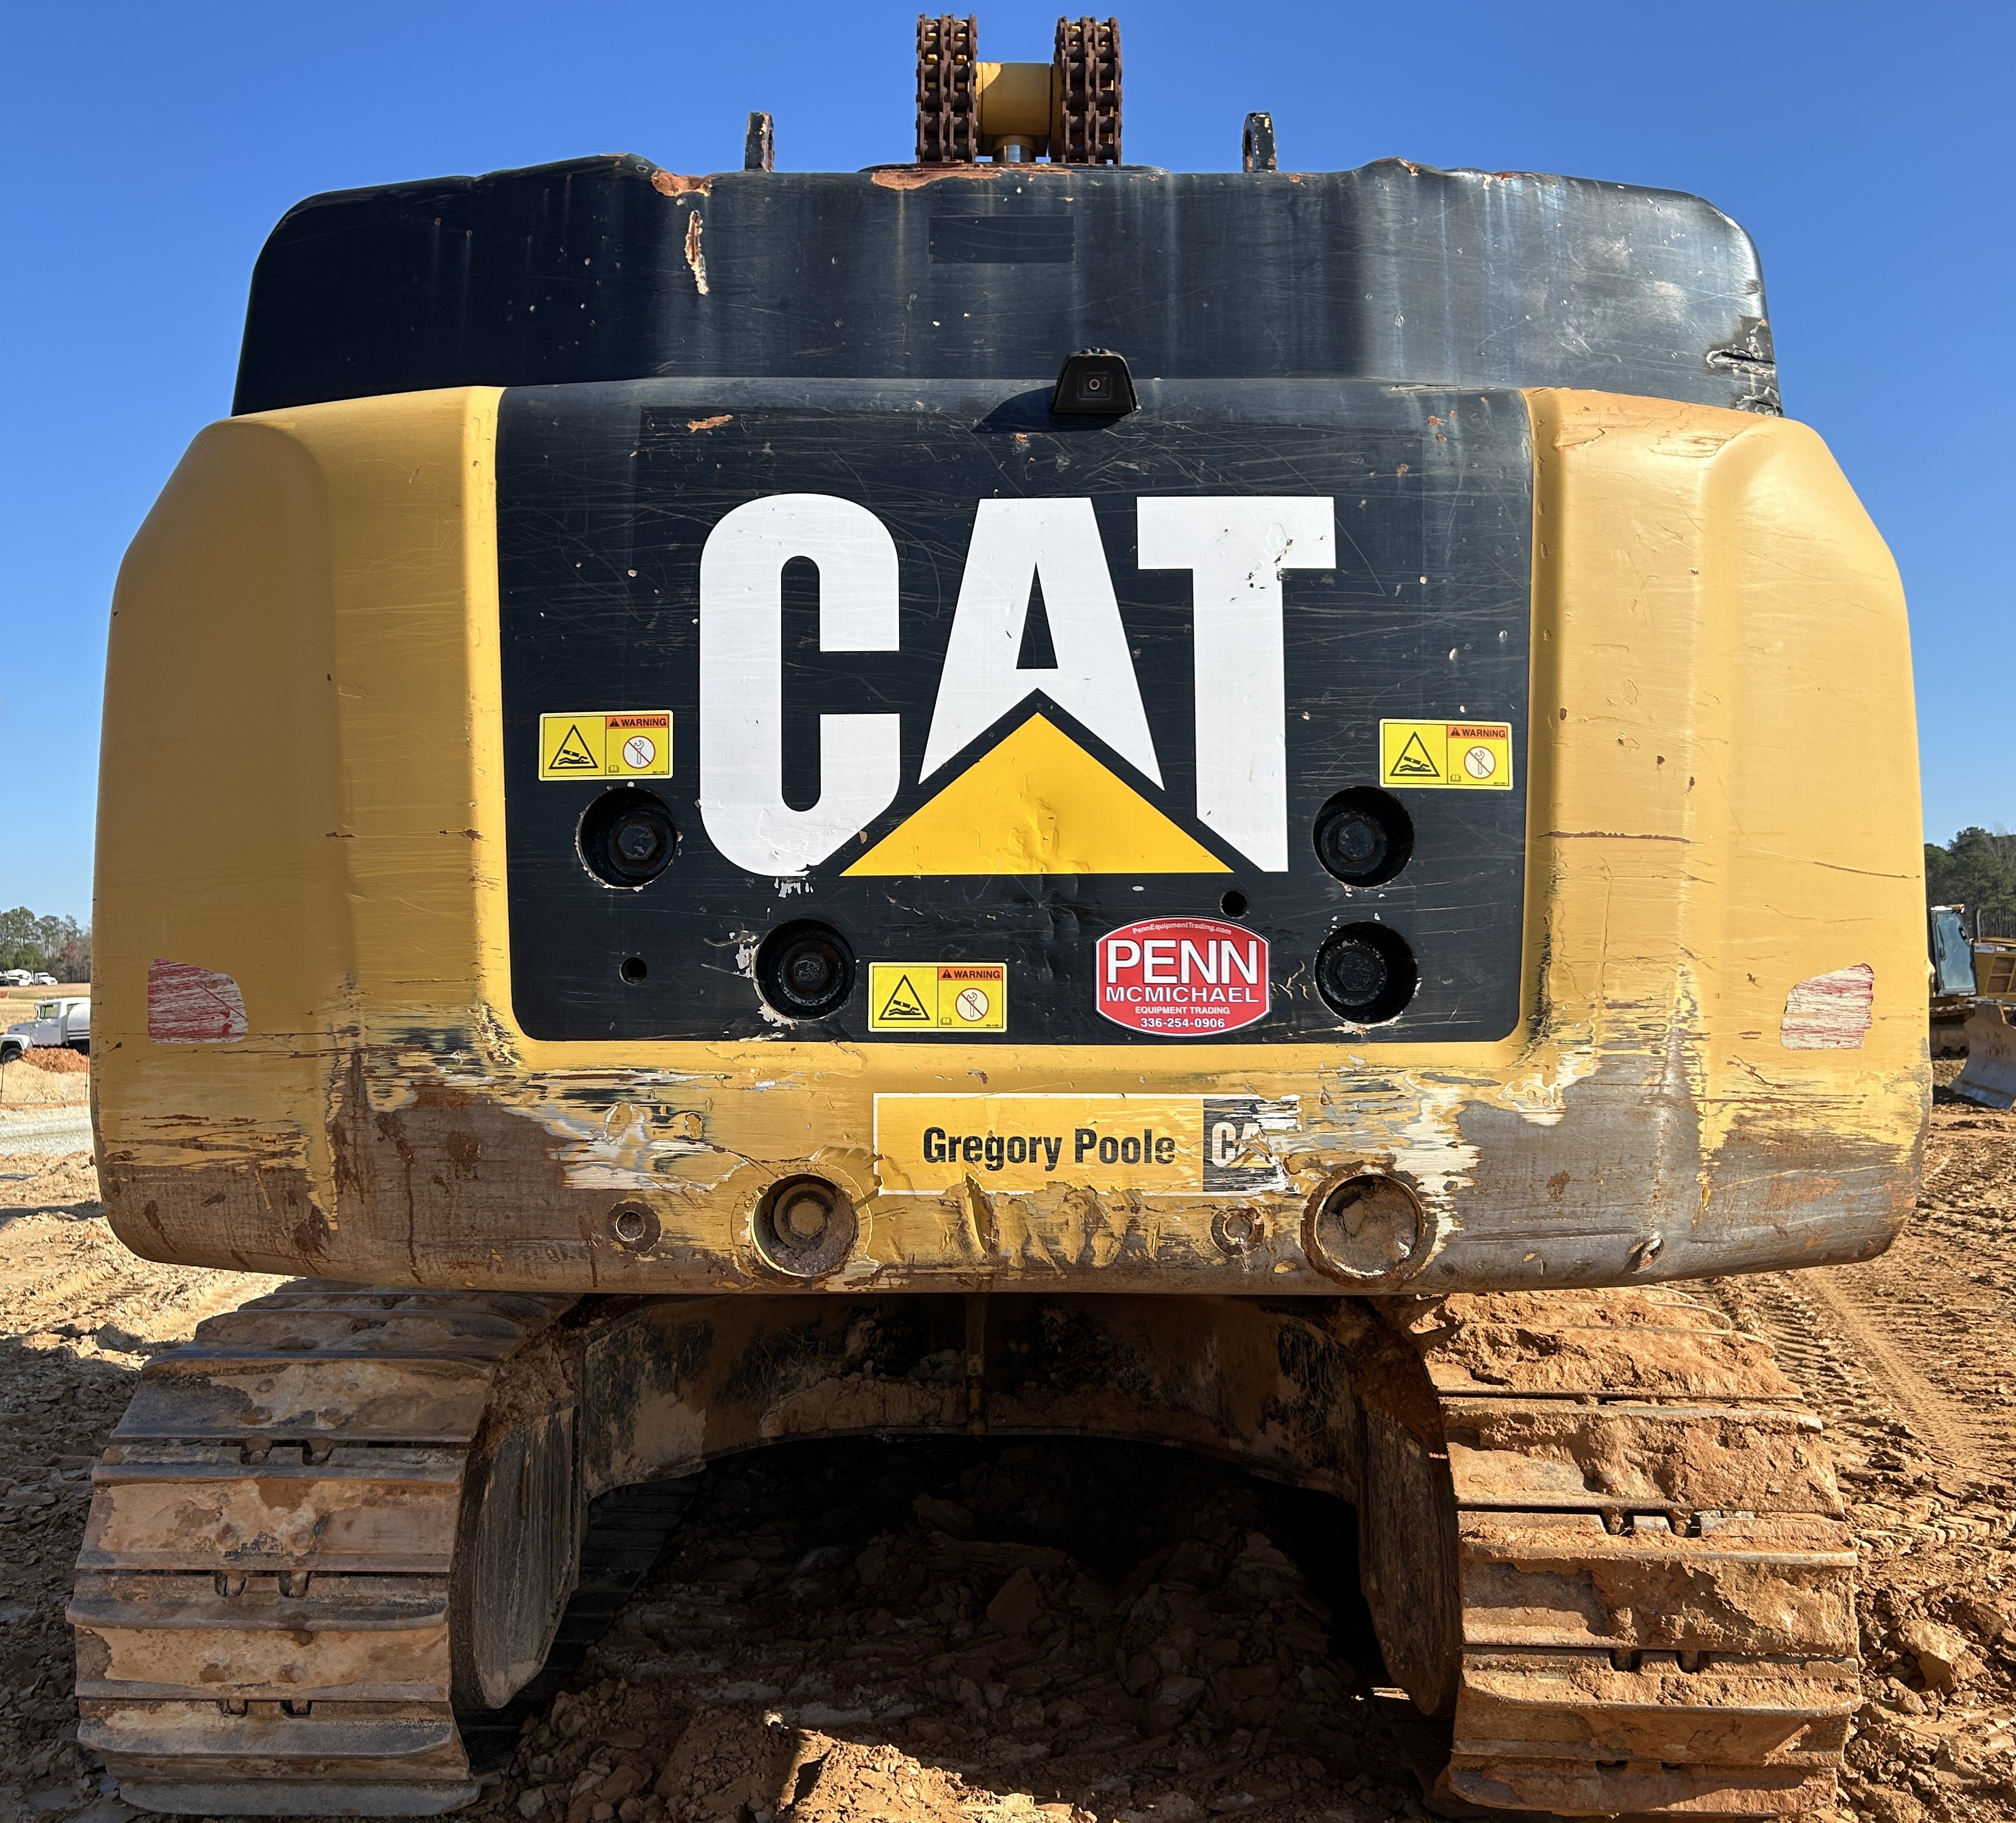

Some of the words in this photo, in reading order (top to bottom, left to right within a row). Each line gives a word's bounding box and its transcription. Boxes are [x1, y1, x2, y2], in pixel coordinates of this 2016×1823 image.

[699, 493, 1337, 877] CAT
[621, 718, 667, 727] WARNING
[1462, 728, 1506, 738] WARNING
[1132, 922, 1232, 935] PennEquipmentTrading.com
[1106, 939, 1258, 984] PENN
[953, 970, 1001, 979] WARNING
[1105, 986, 1260, 1003] MCMICHAEL
[1134, 1006, 1188, 1015] EQUIPMENT
[1190, 1006, 1231, 1015] TRADING
[1140, 1018, 1226, 1028] 336-254-0906
[923, 1126, 1063, 1171] Gregory
[1074, 1128, 1176, 1164] Poole
